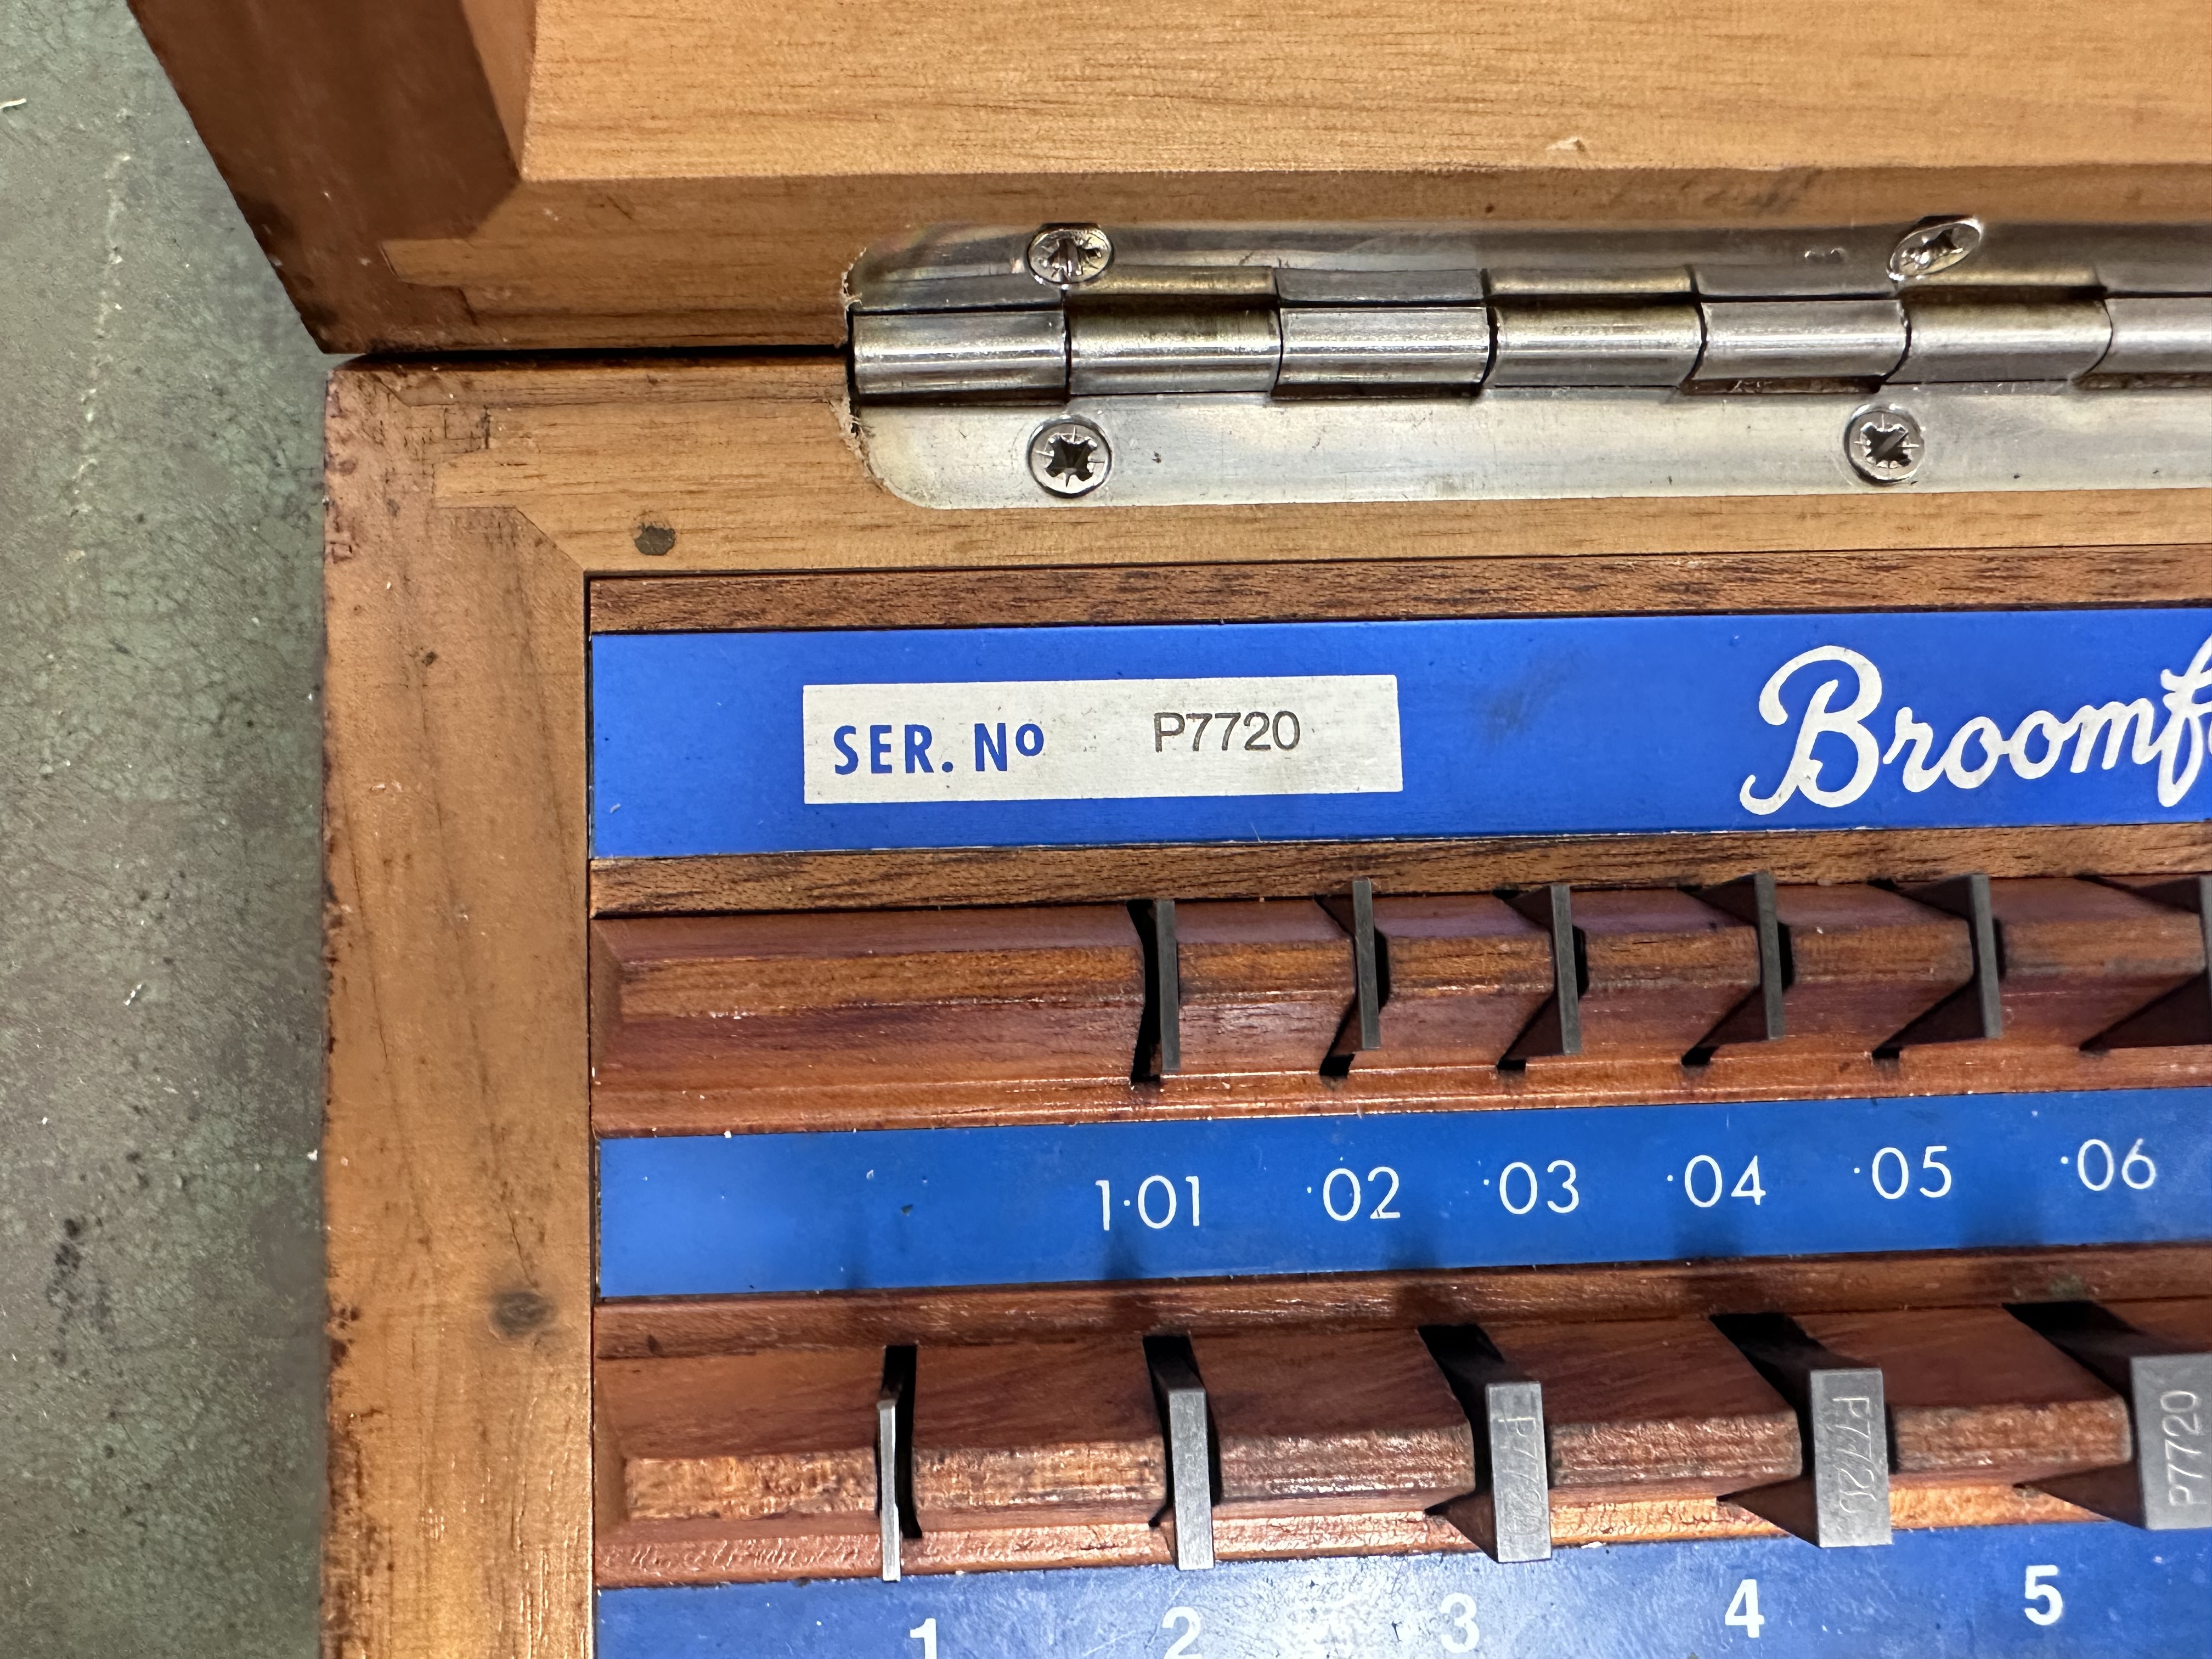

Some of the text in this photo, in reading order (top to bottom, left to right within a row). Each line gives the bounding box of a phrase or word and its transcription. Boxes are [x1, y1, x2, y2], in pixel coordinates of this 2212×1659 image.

[834, 724, 953, 775] SER.
[1153, 710, 1301, 753] P7720
[1739, 633, 2212, 816] Broomf
[2160, 1390, 2209, 1508] P7720
[909, 1564, 2064, 1659] 1 2 3 4 5
